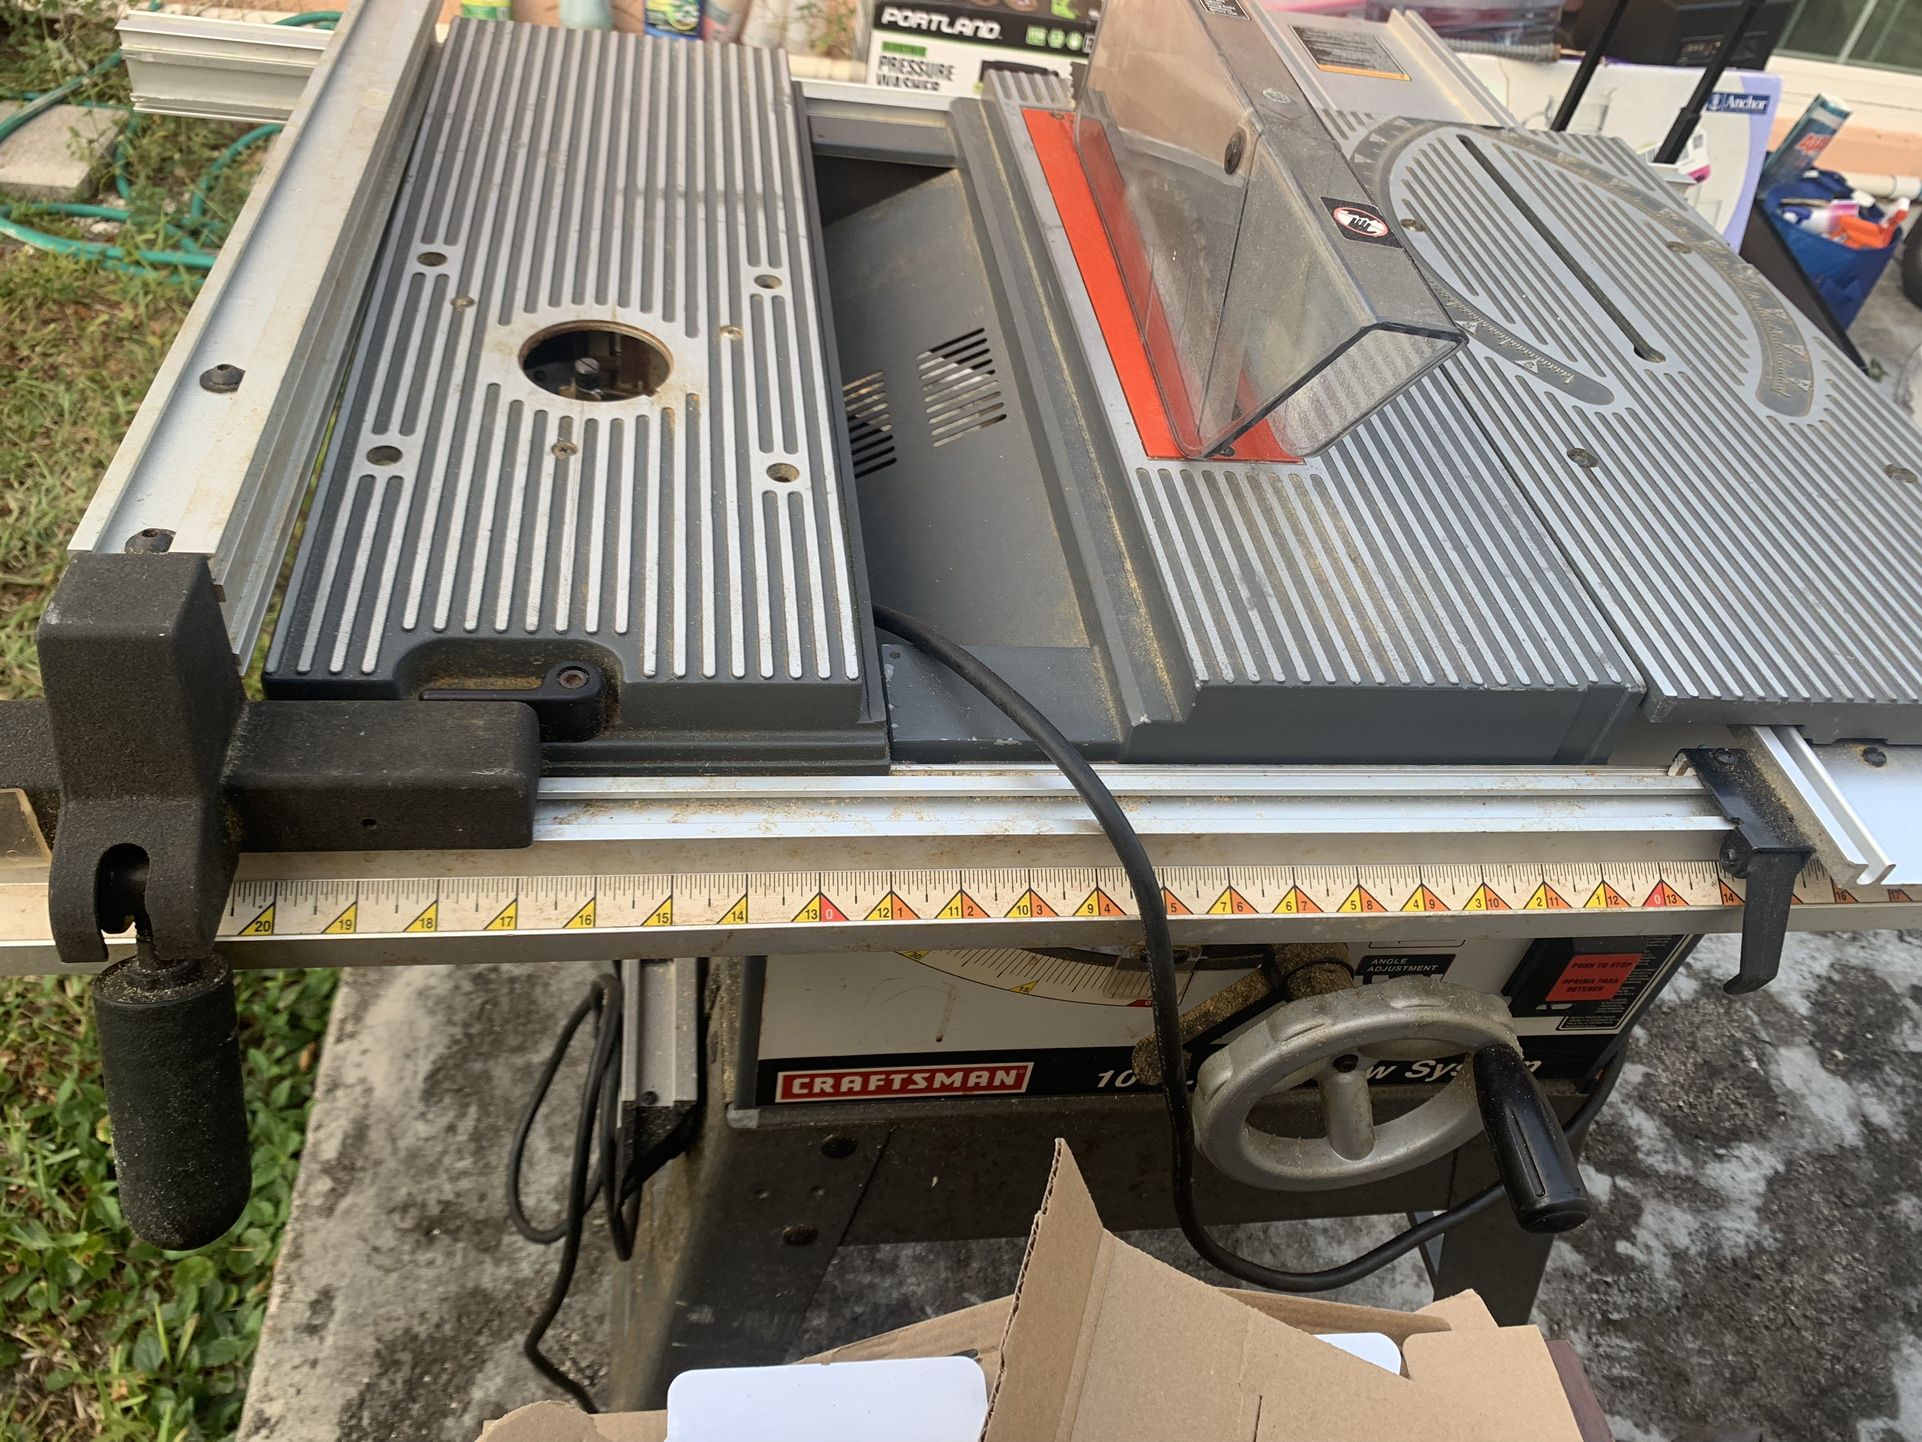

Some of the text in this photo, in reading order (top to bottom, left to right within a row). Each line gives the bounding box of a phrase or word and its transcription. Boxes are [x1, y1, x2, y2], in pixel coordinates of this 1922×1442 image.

[880, 7, 1001, 40] PORTLAND
[878, 55, 956, 81] PRESSURE
[1725, 94, 1768, 110] Anchor
[255, 920, 271, 932] 20
[338, 919, 353, 931] 19
[419, 917, 433, 929] 18
[500, 915, 514, 928] 17
[578, 914, 592, 926] 16
[655, 913, 669, 924] 15
[731, 910, 743, 922] 14
[805, 908, 818, 921] 13
[825, 908, 833, 920] 0
[877, 907, 890, 919] 12
[897, 907, 903, 918] 1
[948, 906, 959, 917] 11
[966, 906, 974, 917] 2
[1016, 904, 1029, 916] 10
[1035, 904, 1044, 916] 3
[1087, 903, 1094, 915] 9
[1103, 903, 1111, 915] 4
[1171, 902, 1177, 912] 5
[1221, 902, 1227, 912] 7
[1236, 902, 1243, 912] 6
[1286, 901, 1292, 912] 6
[1301, 901, 1307, 912] 7
[1351, 900, 1357, 911] 5
[1367, 900, 1373, 911] 8
[1413, 899, 1419, 910] 4
[1429, 899, 1435, 909] 9
[1476, 898, 1482, 909] 3
[1489, 898, 1499, 909] 10
[1537, 897, 1543, 907] 2
[1551, 896, 1560, 907] 11
[1597, 896, 1601, 906] 1
[1608, 895, 1619, 905] 12
[1654, 895, 1660, 905] 0
[1666, 894, 1677, 904] 13
[1724, 893, 1734, 903] 14
[1610, 961, 1633, 969] STOP
[791, 1069, 1018, 1095] CRAFTSMAN
